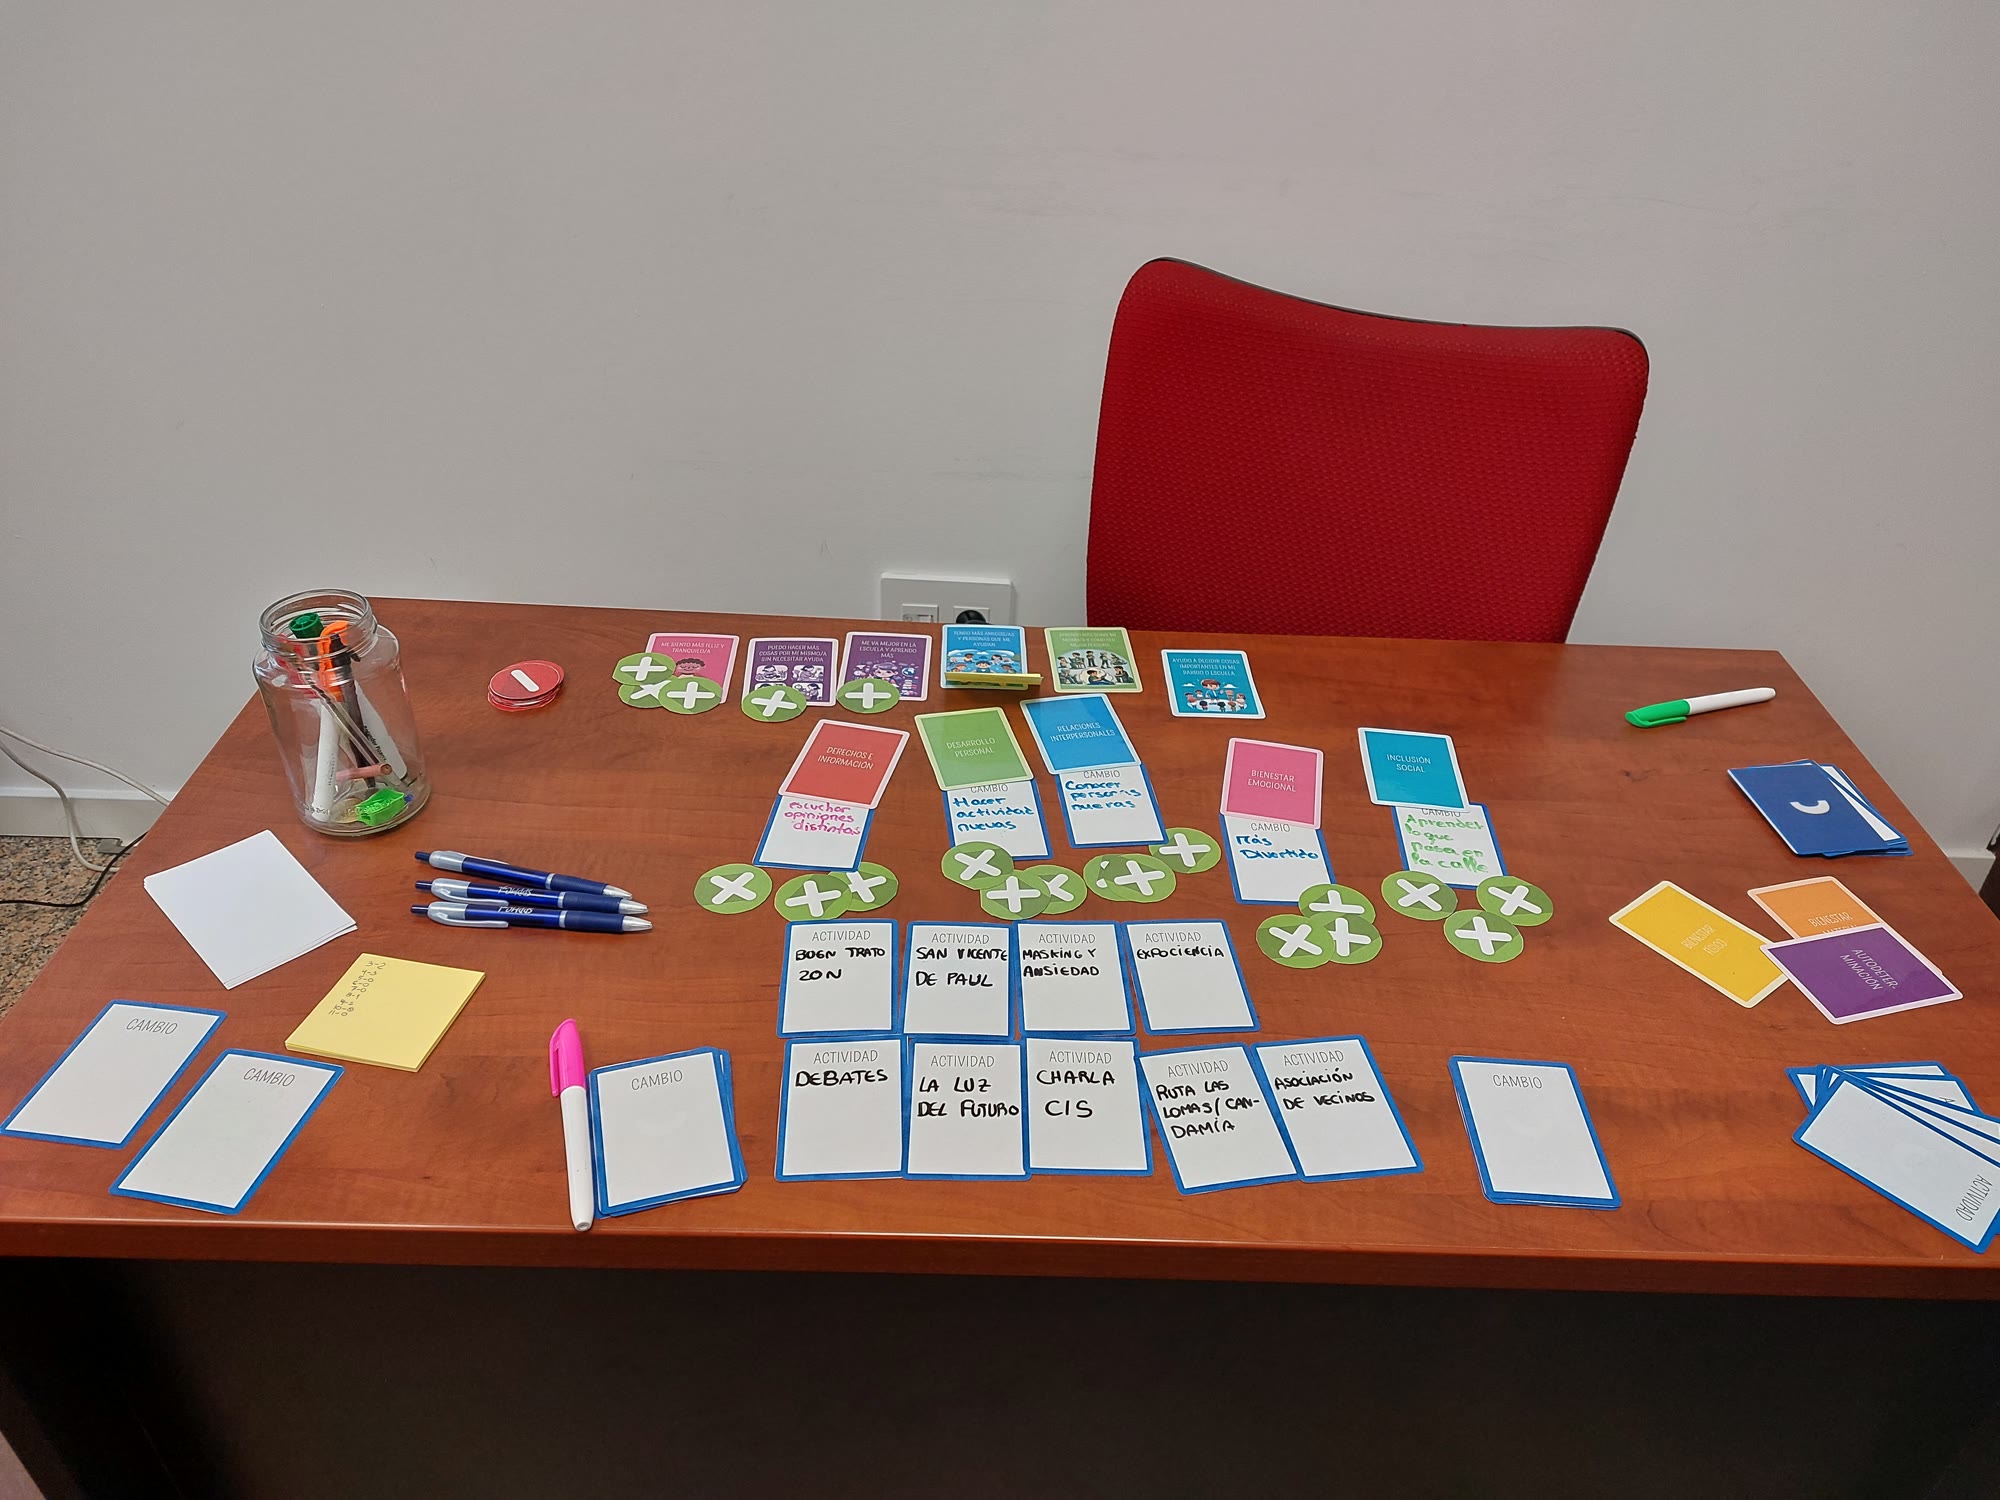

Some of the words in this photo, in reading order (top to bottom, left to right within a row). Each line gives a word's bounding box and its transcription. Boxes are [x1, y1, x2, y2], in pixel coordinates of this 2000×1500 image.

[1057, 722, 1100, 732] RELACIONES
[1050, 729, 1115, 742] INTERPERSONALES
[946, 738, 995, 749] DESARROLLO
[826, 746, 867, 759] DERECHOS
[955, 747, 993, 757] PERSONAL
[818, 755, 874, 770] INFORMACIÓN
[1387, 754, 1431, 764] INCLUSIÓN
[1083, 770, 1120, 778] CAMBIO
[1396, 764, 1425, 772] SOCIAL
[1252, 770, 1295, 782] BIENESTAR
[970, 784, 1008, 793] CAMBIO
[1248, 779, 1296, 792] EMOCIONAL
[784, 812, 854, 823] opiniones
[1250, 823, 1290, 832] CAMBIO
[1808, 912, 1853, 927] BIENESTAR
[812, 931, 871, 941] ACTIVIDAD
[931, 933, 990, 944] ACTIVIDAD
[1039, 934, 1095, 944] ACTIVIDAD
[1145, 932, 1201, 943] ACTIVIDAD
[845, 947, 886, 958] TRATO
[916, 947, 948, 960] SAN
[957, 948, 1008, 961] VICENTE
[1087, 948, 1097, 958] Y
[1840, 954, 1883, 990] MINACIÓN
[1852, 949, 1898, 989] AUTODETER-
[916, 971, 938, 986] DE
[947, 972, 993, 987] PAUL
[126, 1018, 178, 1036] CAMBIO
[813, 1050, 878, 1064] ACTIVIDAD
[931, 1055, 994, 1067] ACTIVIDAD
[1050, 1051, 1112, 1064] ACTIVIDAD
[1283, 1050, 1344, 1067] ACTIVIDAD
[1168, 1060, 1229, 1078] ACTIVIDAD
[243, 1068, 296, 1087] CAMBIO
[631, 1069, 683, 1091] CAMBIO
[795, 1069, 888, 1087] DEBATES
[919, 1076, 939, 1092] LA
[954, 1077, 992, 1092] LUZ
[1036, 1070, 1115, 1086] CHARLA
[1493, 1075, 1543, 1089] CAMBIO
[1156, 1084, 1196, 1101] RUTA
[1204, 1080, 1229, 1093] LAS
[917, 1102, 947, 1117] DEL
[960, 1099, 1019, 1118] FUTURO
[1045, 1100, 1093, 1118] CIS
[1283, 1097, 1305, 1110] DE
[1955, 1174, 1993, 1222] ACTIVIDAD
